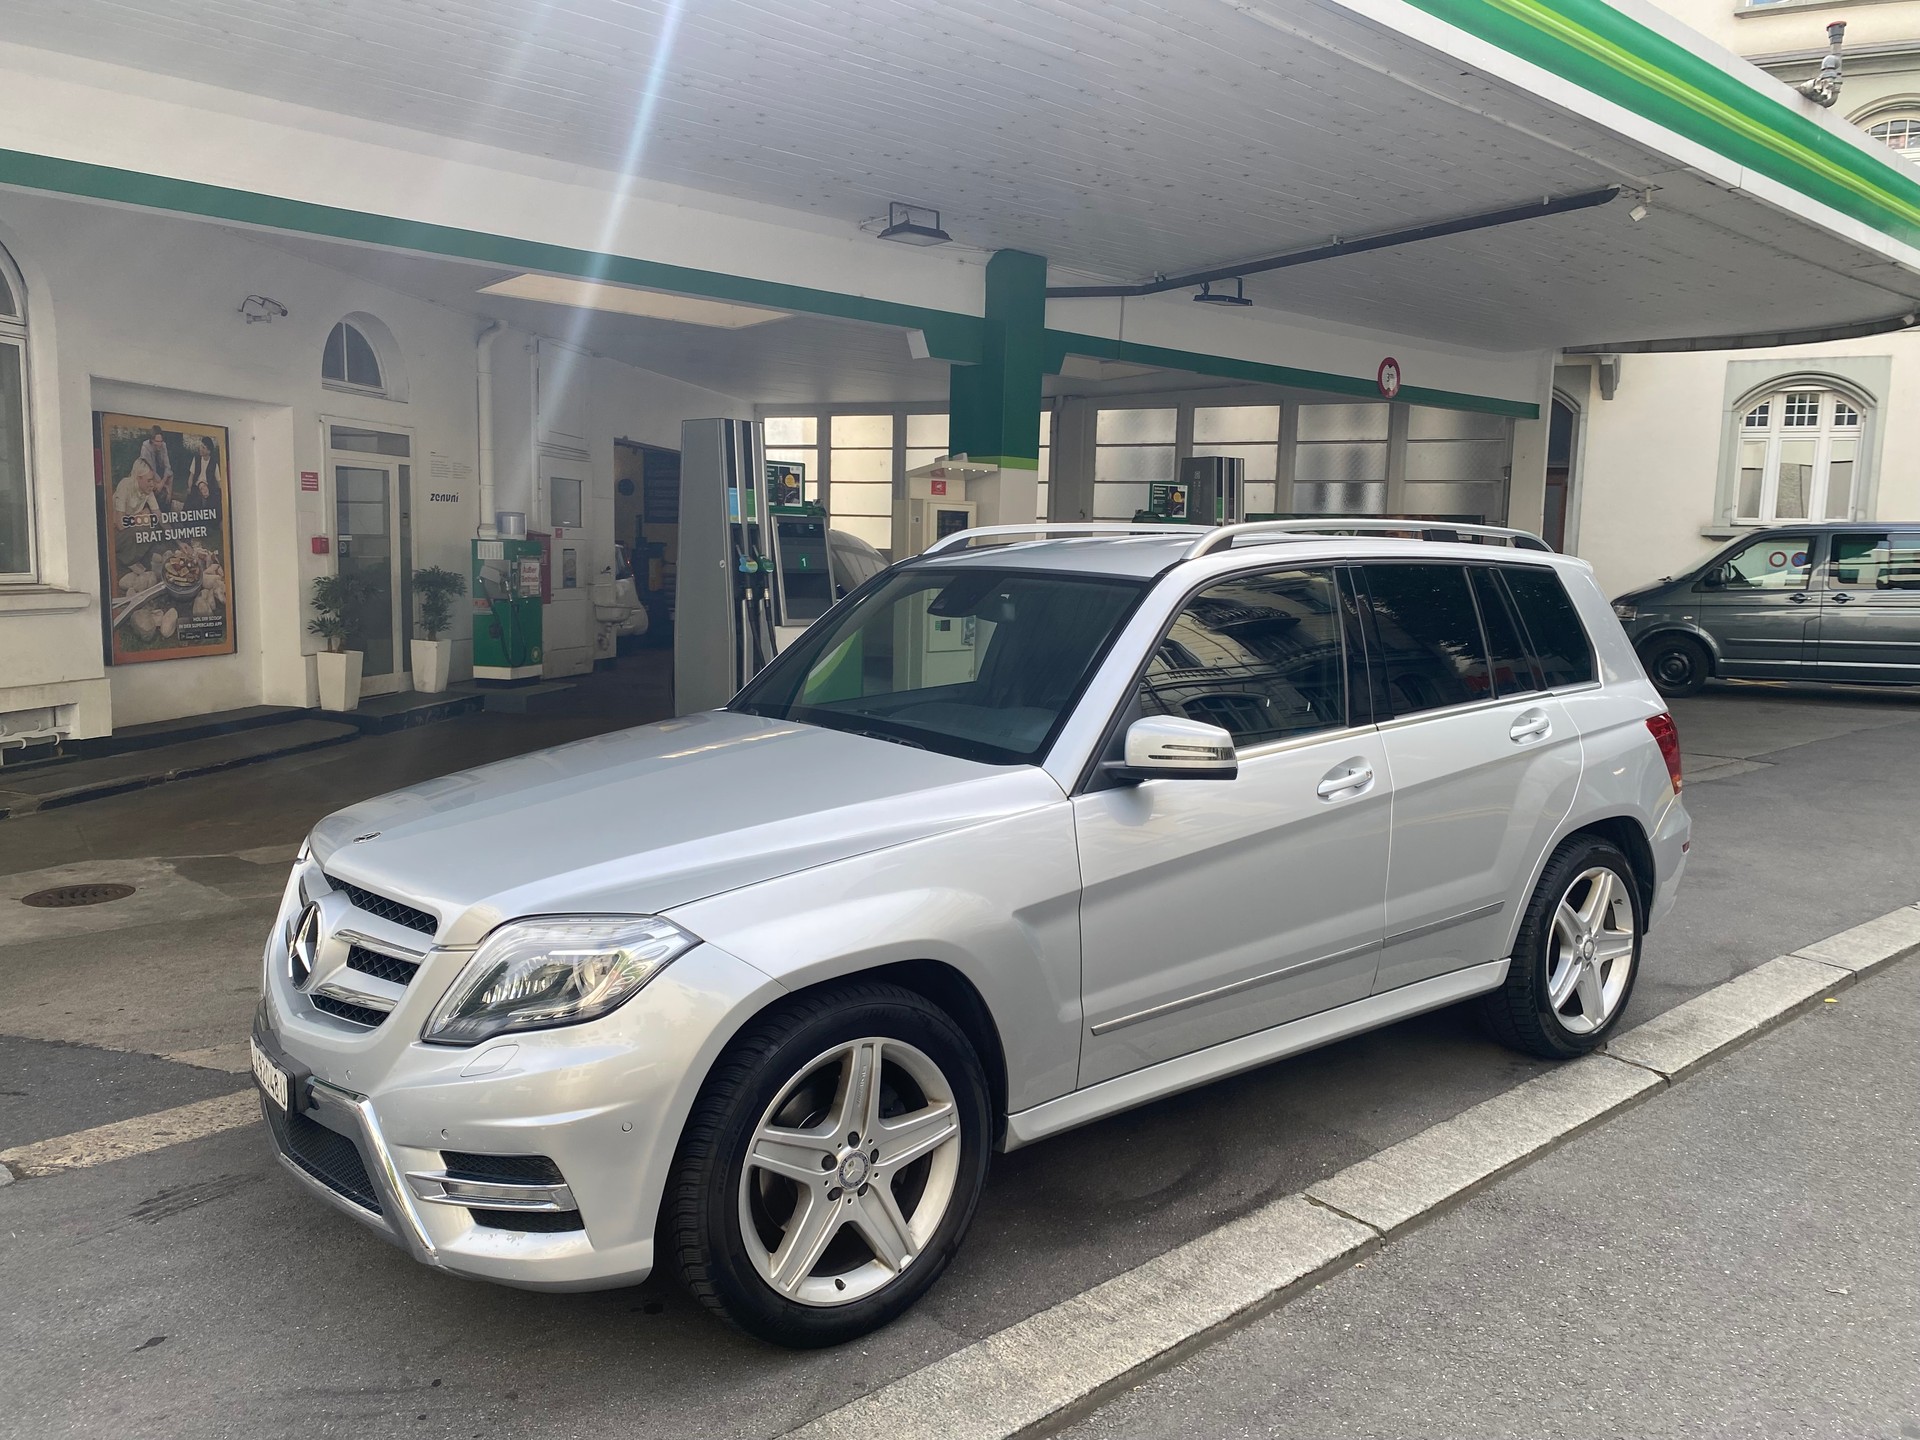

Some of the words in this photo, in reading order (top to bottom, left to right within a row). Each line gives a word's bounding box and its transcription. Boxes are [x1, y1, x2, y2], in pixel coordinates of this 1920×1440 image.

[161, 511, 179, 523] DIR
[180, 509, 217, 521] DEINEN
[135, 530, 162, 544] BRAT
[165, 526, 207, 540] SUMMER
